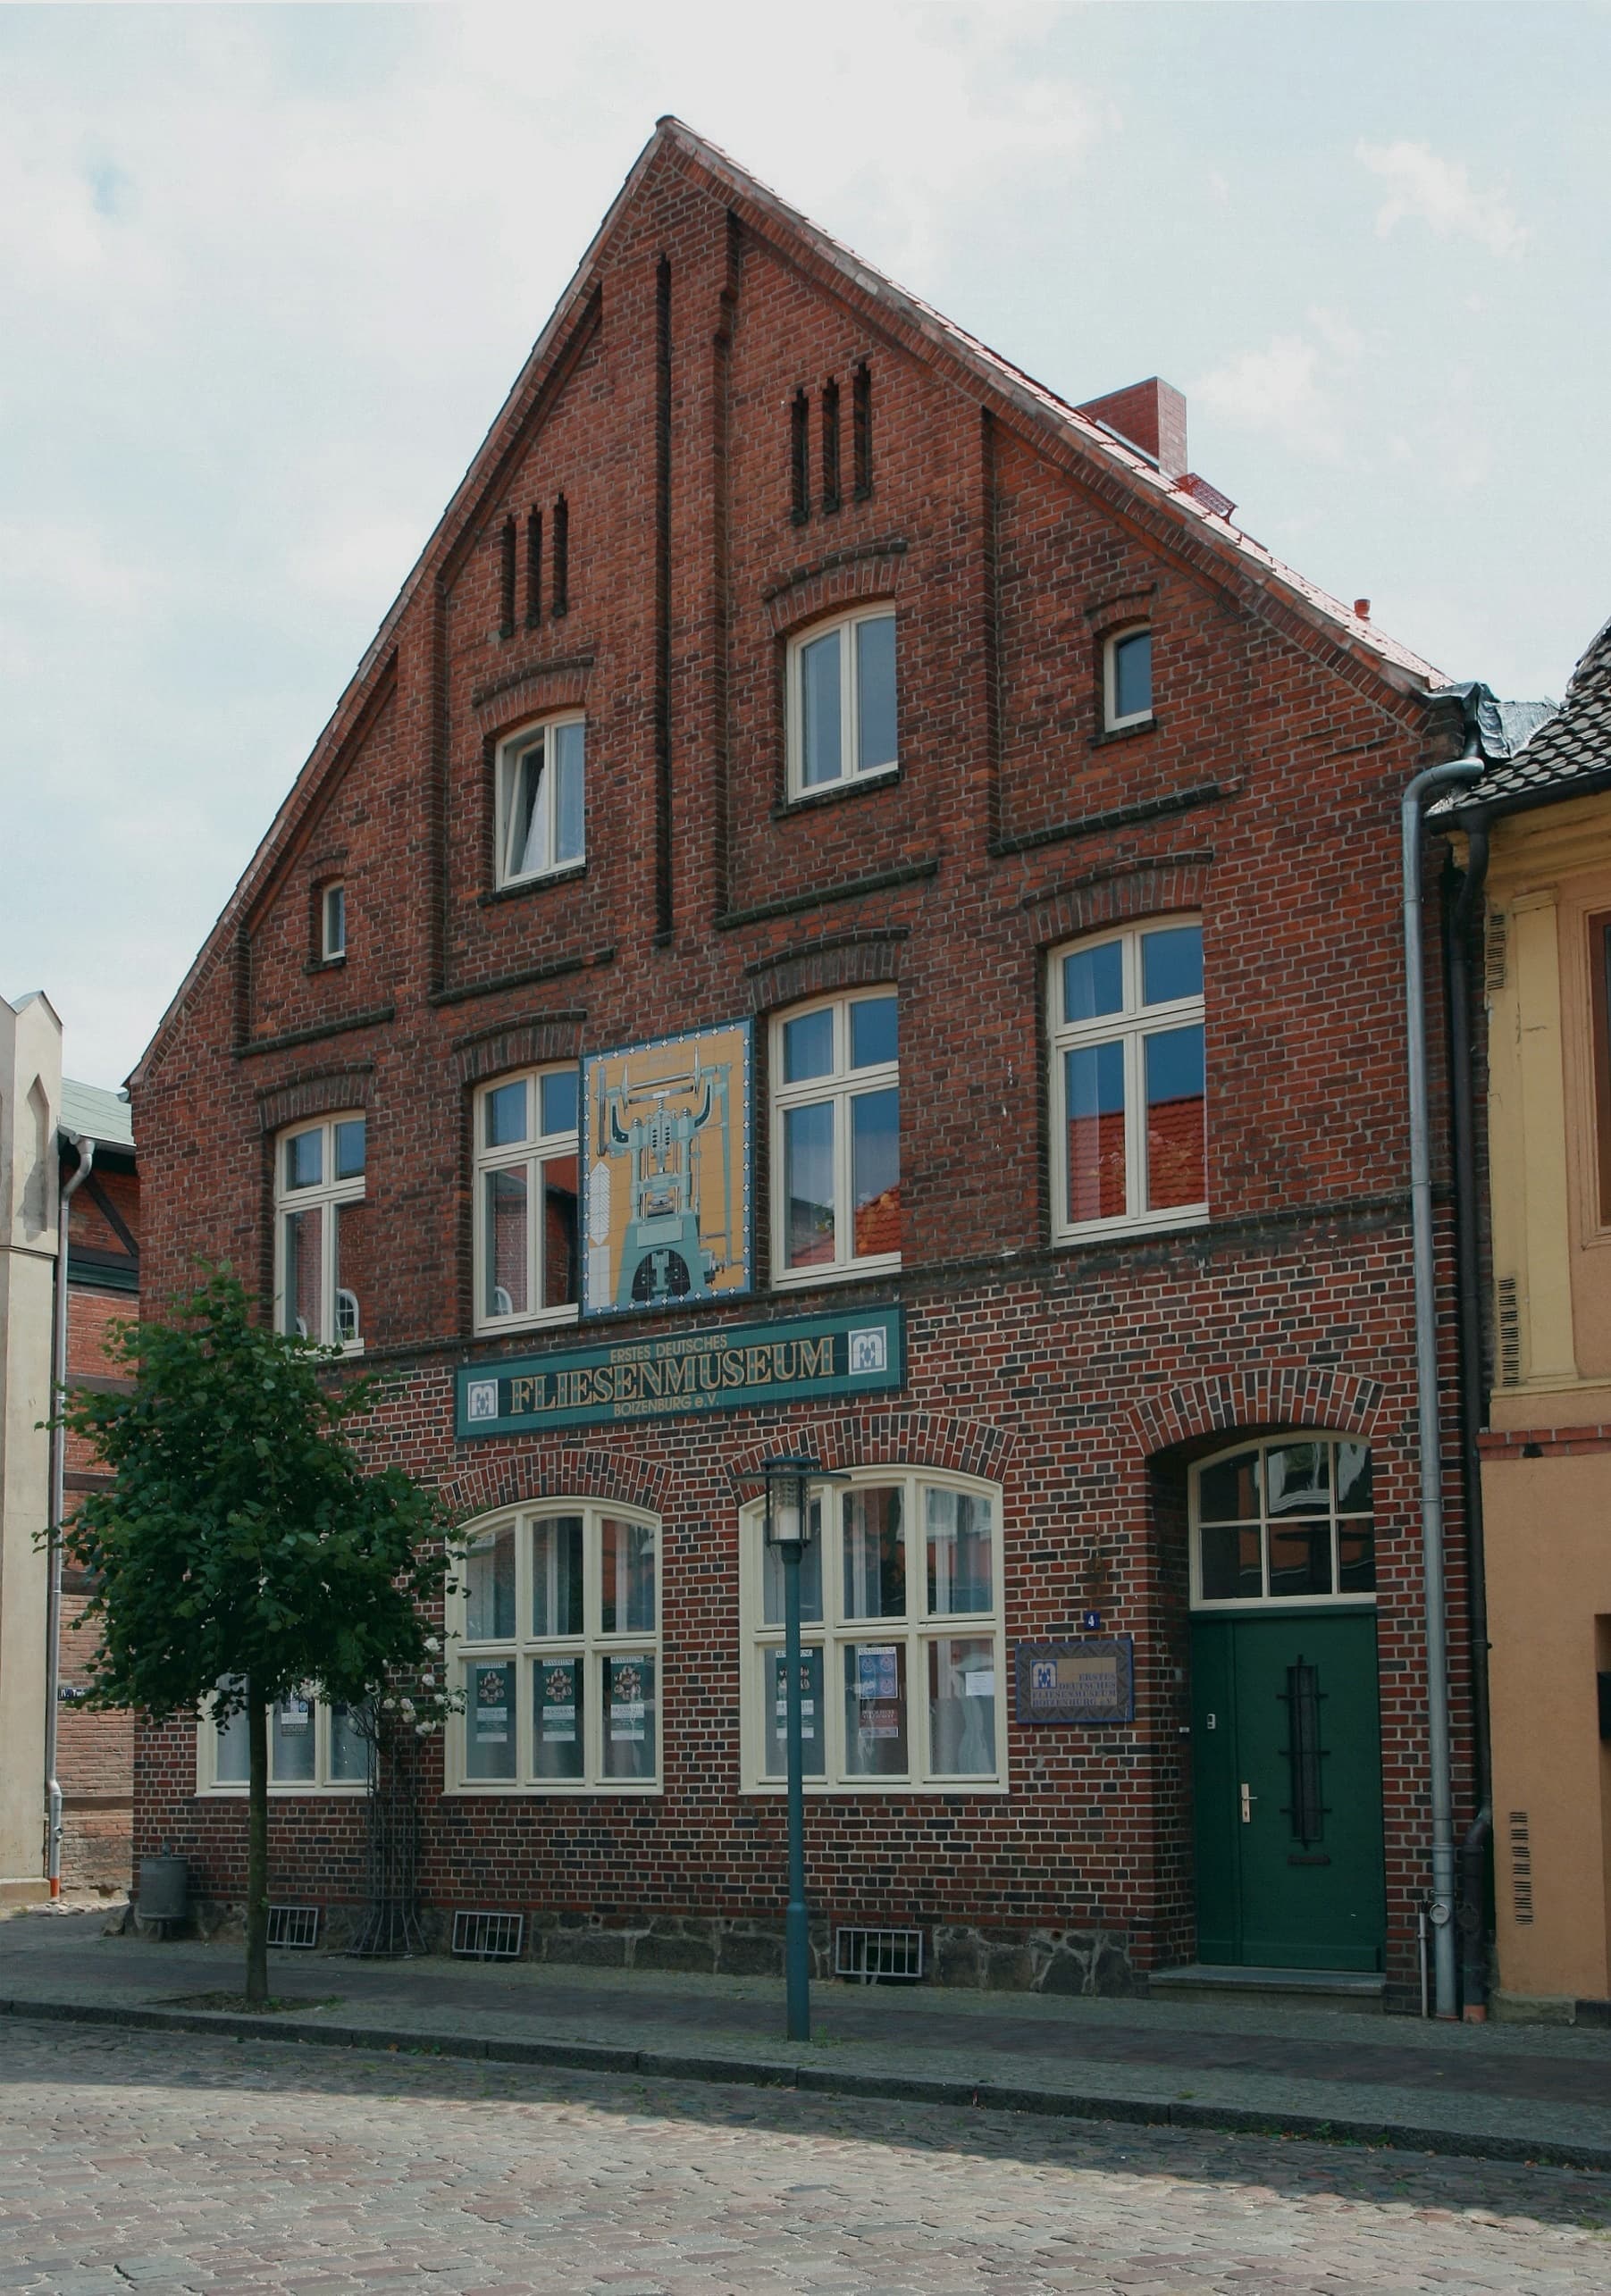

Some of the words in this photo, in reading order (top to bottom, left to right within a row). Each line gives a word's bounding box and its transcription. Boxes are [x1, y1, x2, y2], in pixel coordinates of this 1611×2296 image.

[610, 1345, 651, 1363] ERSTES
[656, 1334, 727, 1358] DEUTSCHES
[509, 1337, 835, 1414] FLIESENMUSEUM
[614, 1395, 692, 1417] BOIZENBURG
[694, 1392, 719, 1408] e.V.
[1087, 1614, 1095, 1627] 4
